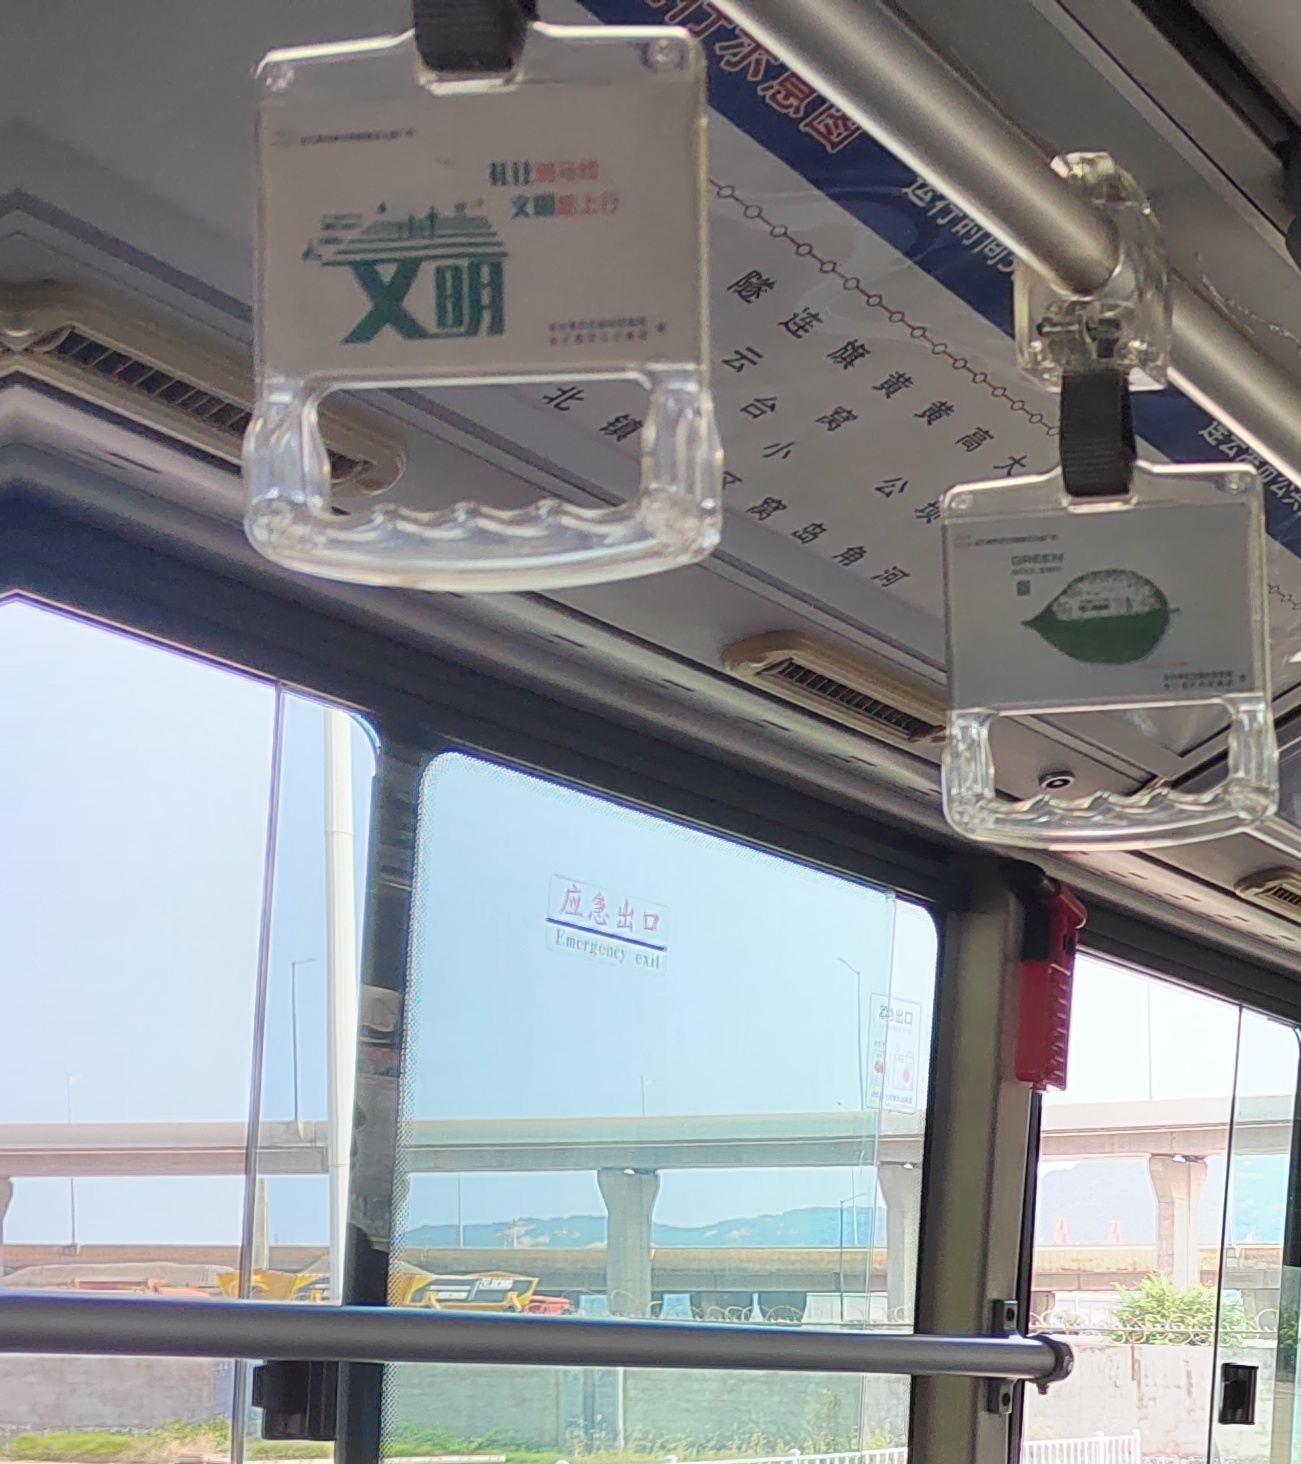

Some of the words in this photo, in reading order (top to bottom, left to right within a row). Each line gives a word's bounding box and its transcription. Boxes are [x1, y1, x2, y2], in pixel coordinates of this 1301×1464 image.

[559, 882, 661, 932] 应急出口
[556, 929, 627, 963] Emergency
[634, 951, 661, 969] exit
